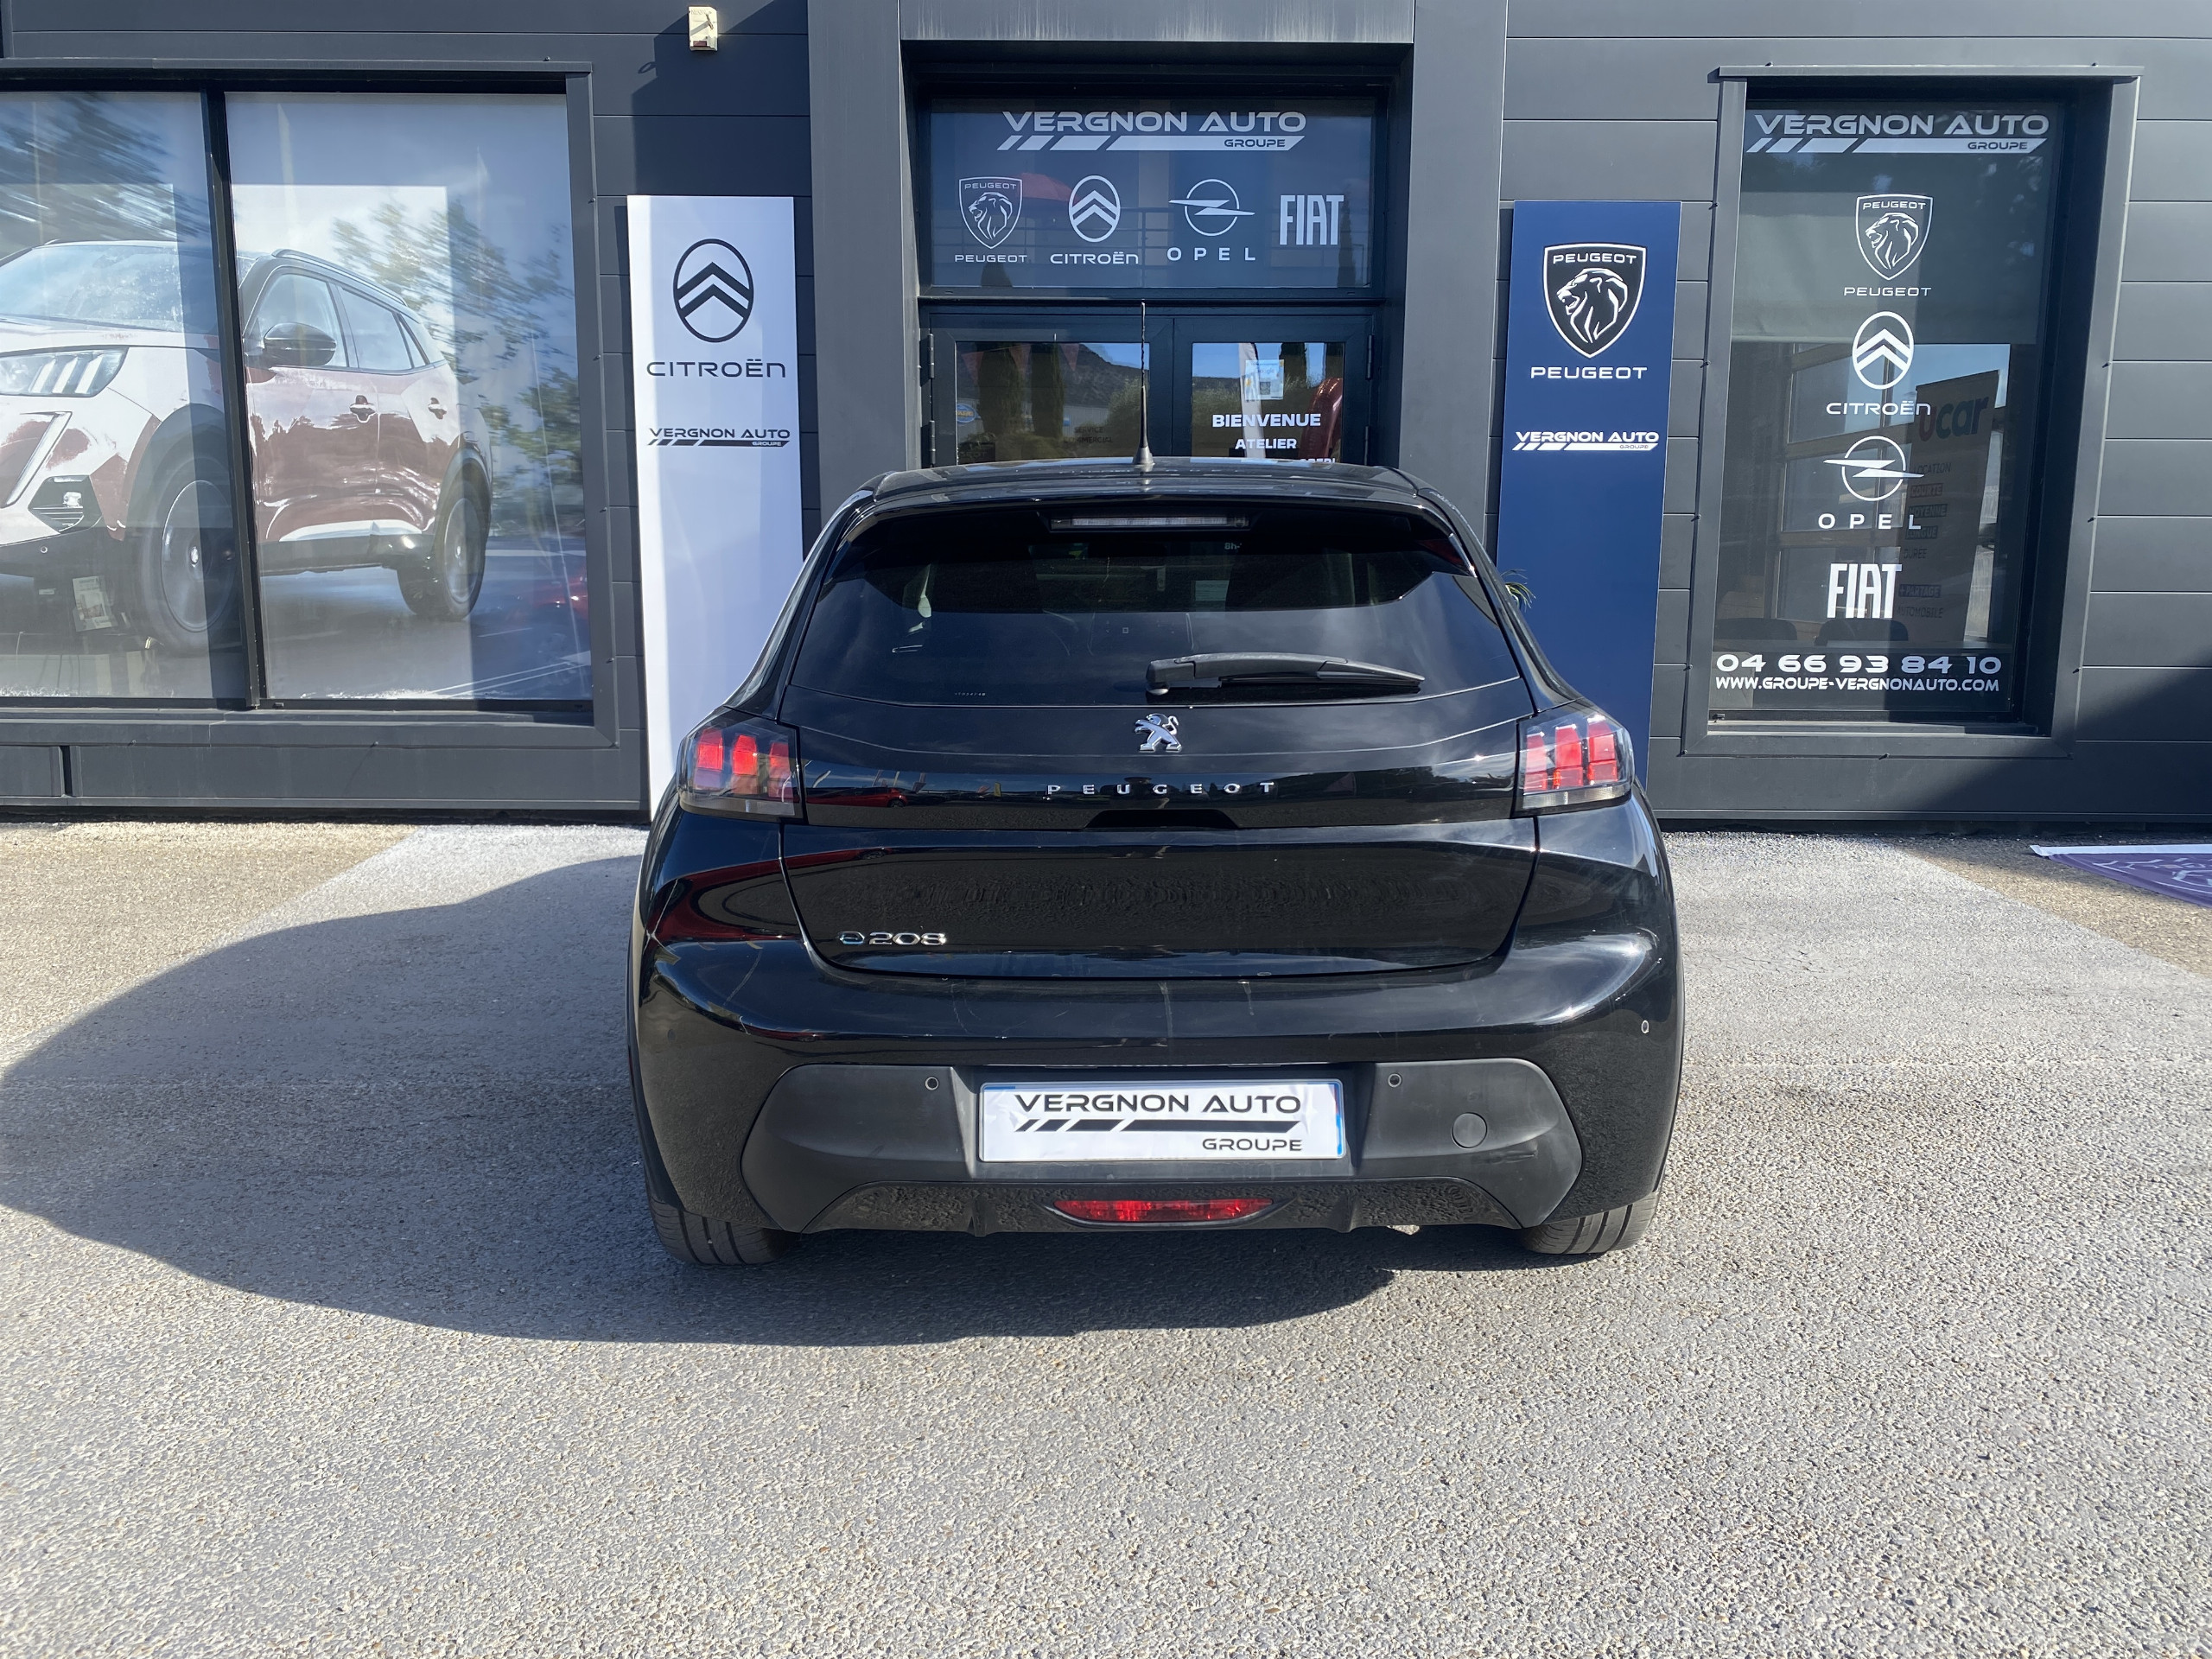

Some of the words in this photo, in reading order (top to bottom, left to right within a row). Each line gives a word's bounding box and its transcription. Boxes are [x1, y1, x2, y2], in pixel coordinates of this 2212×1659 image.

[1002, 111, 1188, 132] VERGNON
[1198, 111, 1306, 132] AUTO
[1754, 114, 1934, 135] VERGNON
[1944, 115, 2050, 136] AUTO
[1224, 138, 1287, 148] GROUPE
[1967, 142, 2028, 150] GROUPE
[964, 182, 1017, 191] PEUGEOT
[1862, 200, 1927, 210] PEUGEOT
[1280, 194, 1344, 245] FIAT
[955, 254, 1027, 263] PEUGEOT
[1050, 251, 1139, 264] CITROËN
[1167, 247, 1256, 261] OPEL
[1553, 252, 1637, 264] PEUGEOT
[1844, 287, 1931, 296] PEUGEOT
[646, 359, 786, 378] CITROËN
[1530, 366, 1648, 379] PEUGEOT
[1826, 400, 1931, 416] CITROËN
[1212, 413, 1321, 428] BIENVENUE
[649, 428, 735, 439] VERGNON
[741, 429, 791, 439] AUTO
[1516, 431, 1603, 442] VERGNON
[1608, 431, 1660, 443] AUTO
[1235, 438, 1297, 450] ATELIER
[1911, 484, 1942, 498] COURTE
[1818, 513, 1922, 530] OPEL
[1827, 563, 1902, 619] FIAT
[1716, 654, 1766, 672] 04
[1778, 654, 1827, 673] 66
[1840, 655, 1890, 673] 93
[1901, 656, 1953, 674] 84
[1966, 656, 2002, 674] 10
[1715, 677, 1999, 691] WWW.GROUPE-VERGNONAUTO.COM
[1046, 781, 1276, 796] PEUGEOT
[1014, 1094, 1189, 1113] VERGNON
[1201, 1095, 1301, 1114] AUTO
[1202, 1138, 1303, 1152] GROUPE
